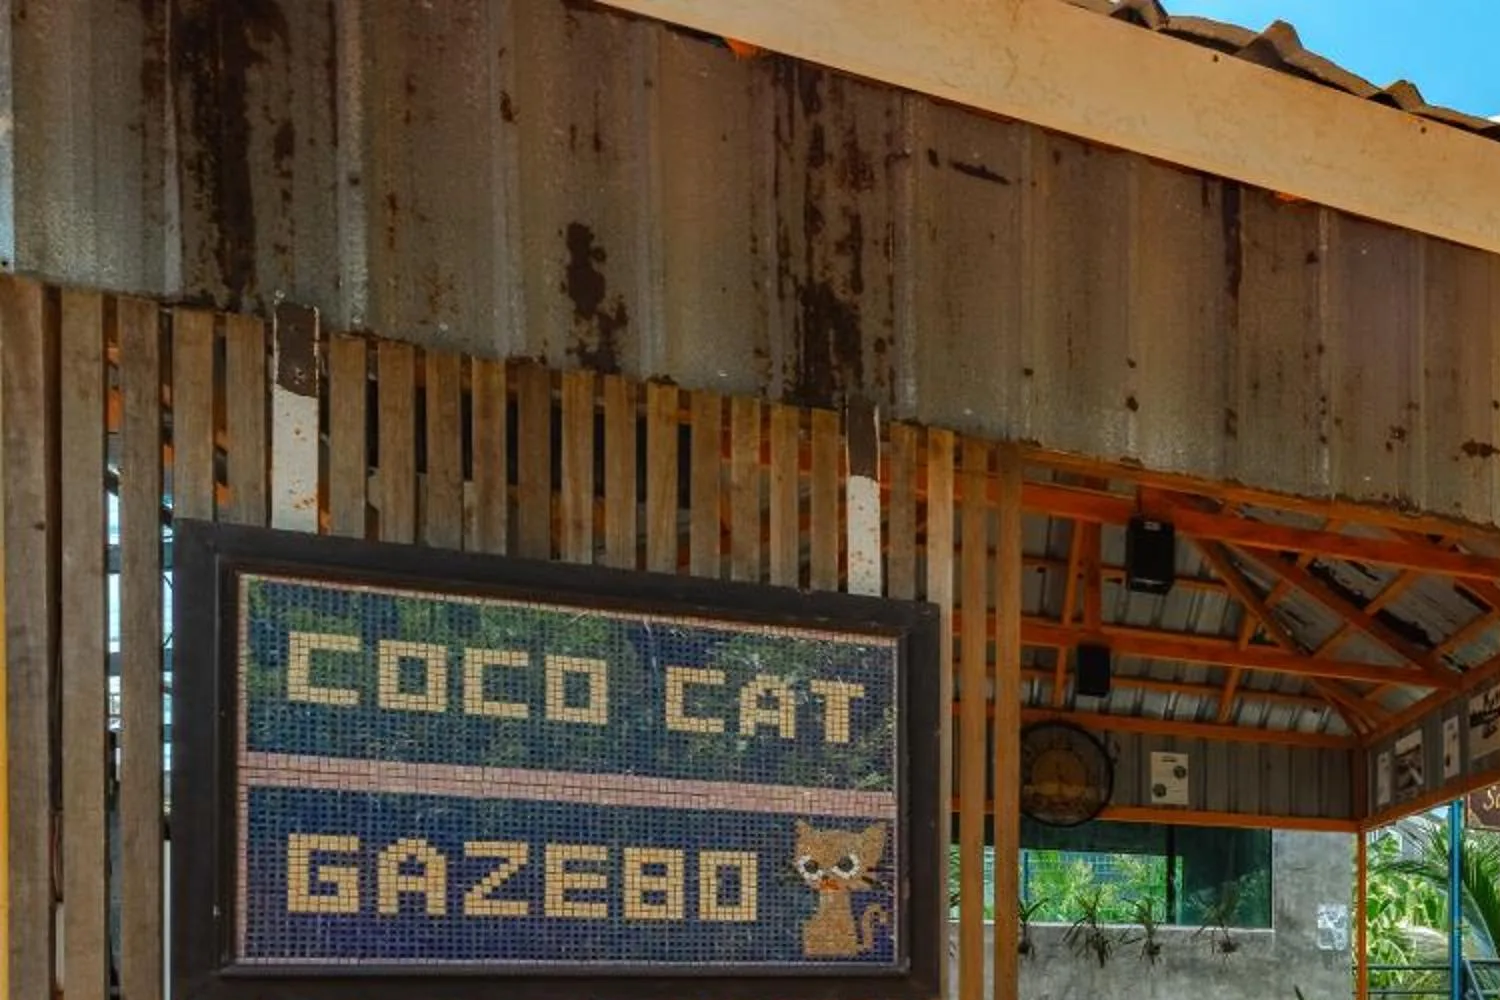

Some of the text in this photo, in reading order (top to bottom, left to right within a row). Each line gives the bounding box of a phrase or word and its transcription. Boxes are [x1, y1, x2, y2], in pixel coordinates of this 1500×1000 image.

[287, 631, 865, 743] COCO CAT
[287, 833, 758, 921] GAZEBO
